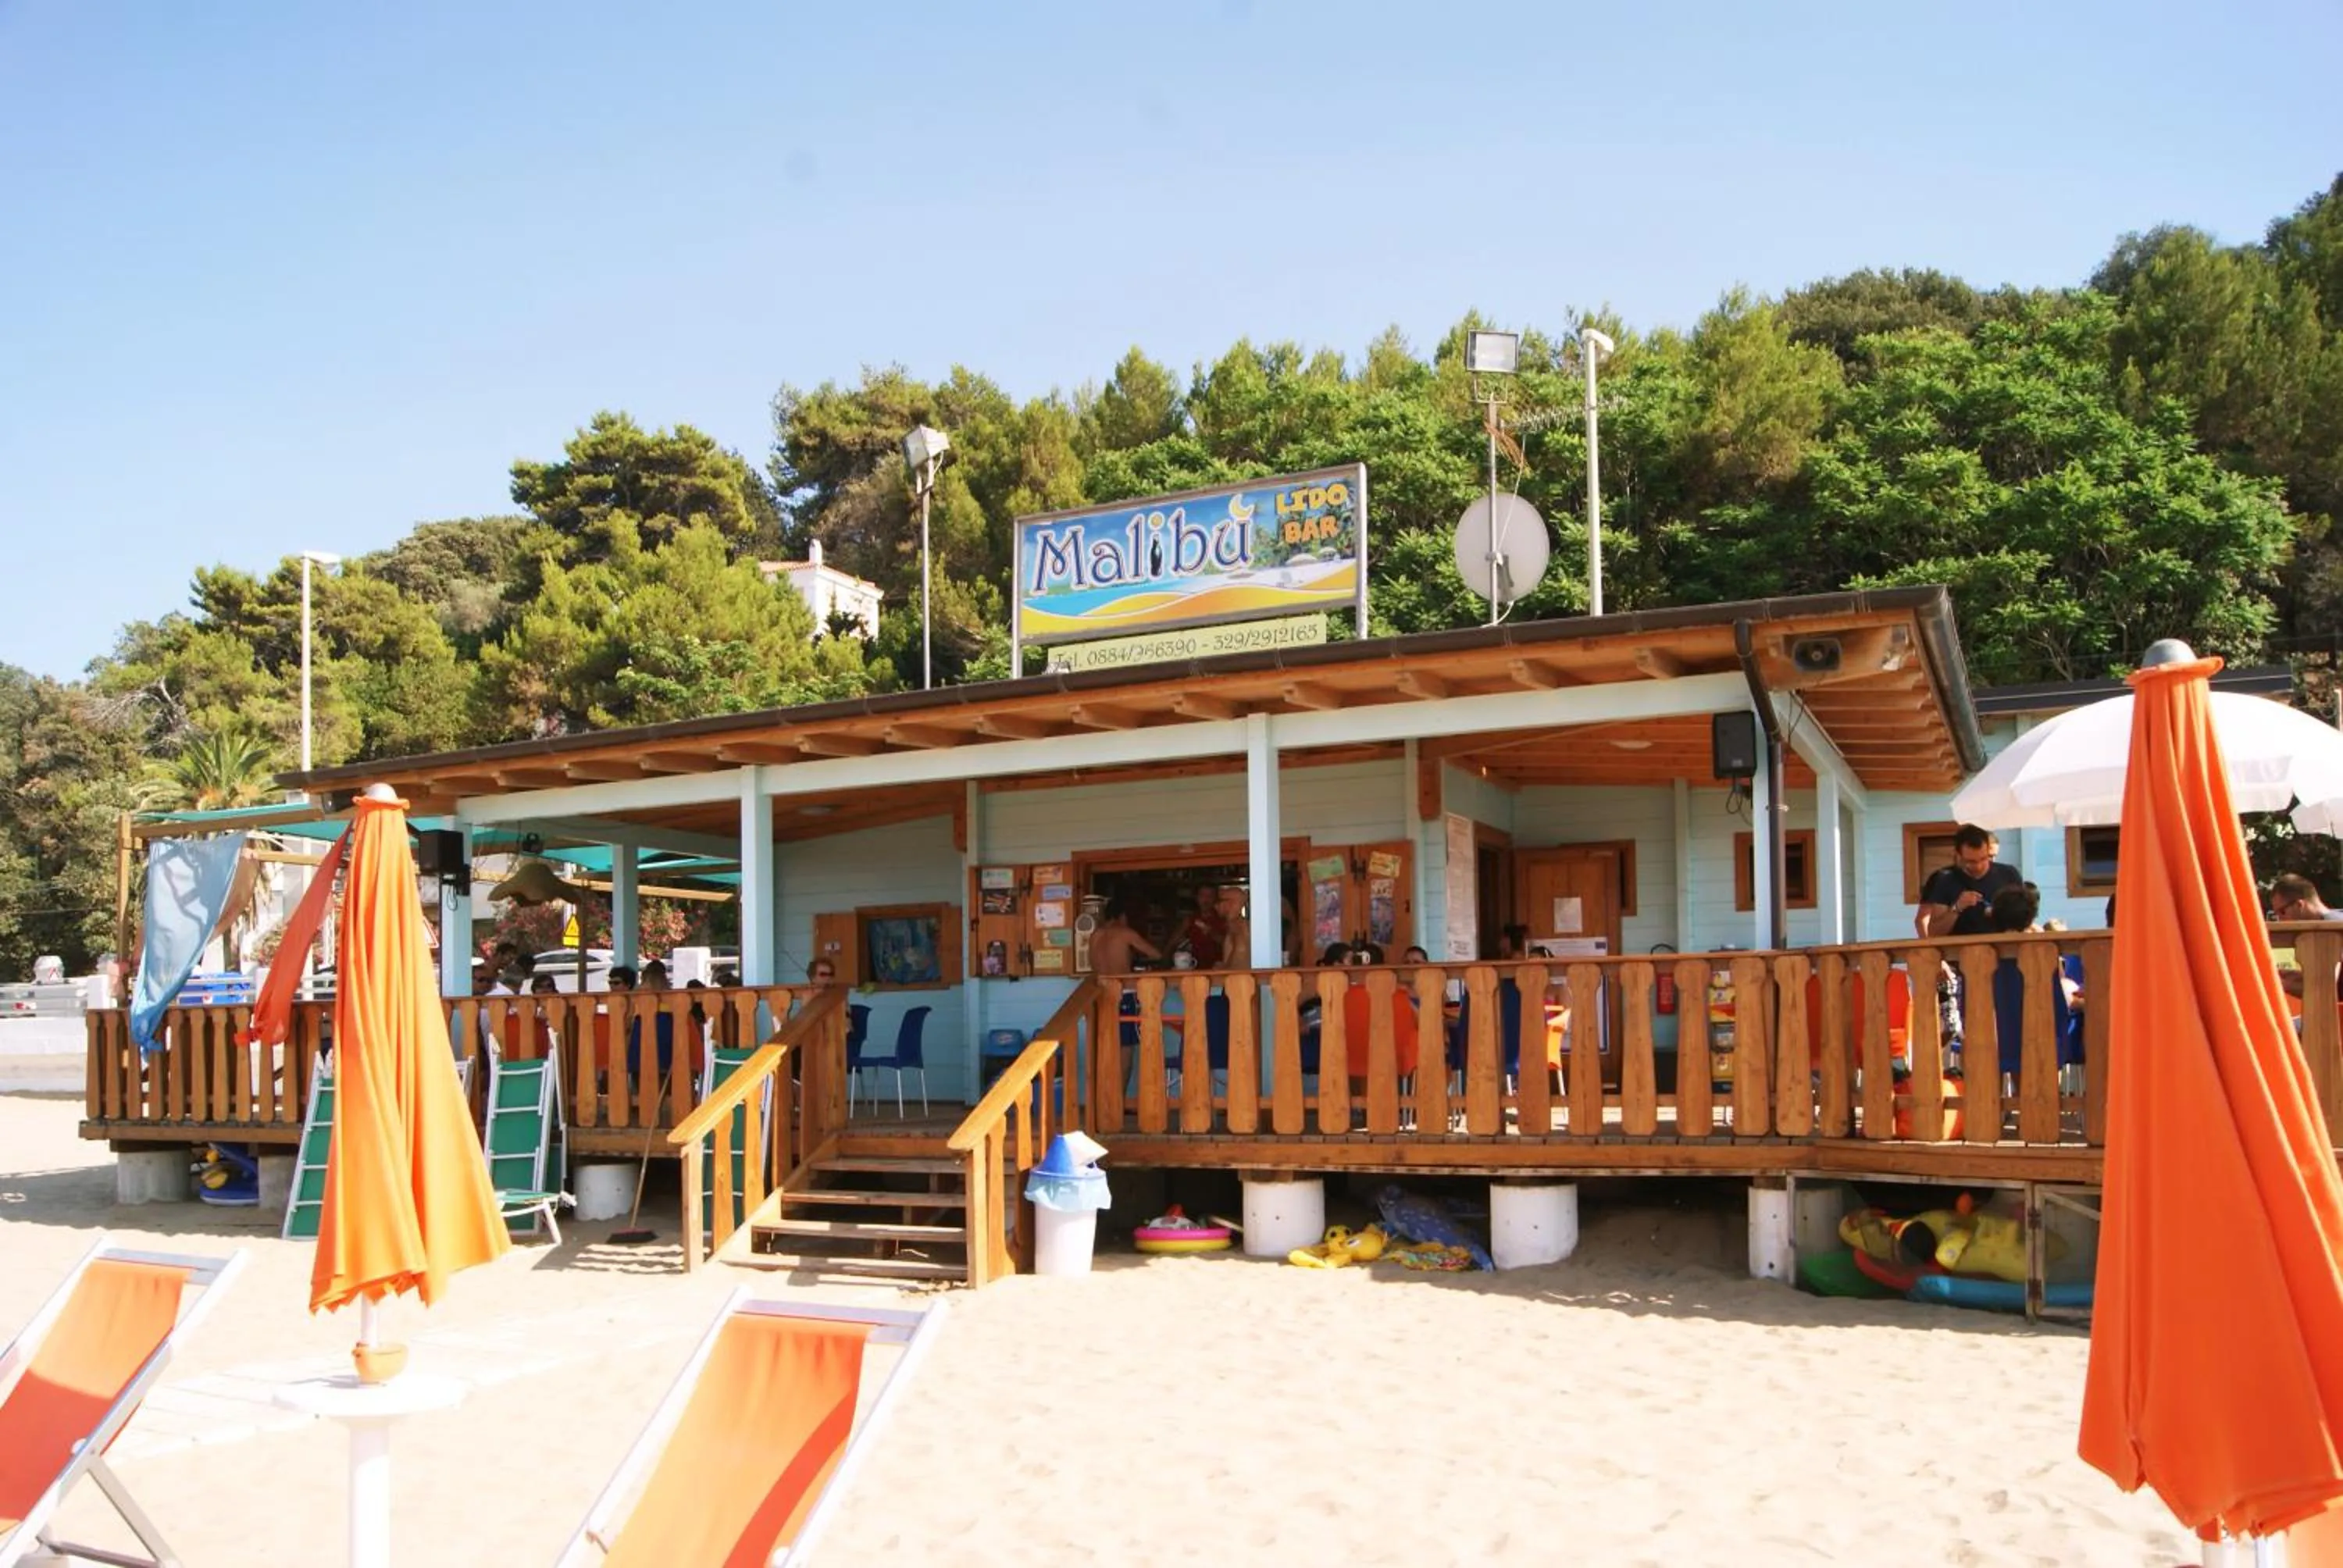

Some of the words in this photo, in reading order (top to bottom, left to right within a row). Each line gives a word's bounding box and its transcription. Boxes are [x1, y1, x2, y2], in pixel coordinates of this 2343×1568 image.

[1275, 483, 1349, 515] LIDO
[1283, 515, 1339, 543] BAR
[1213, 624, 1318, 650] 329/2912165
